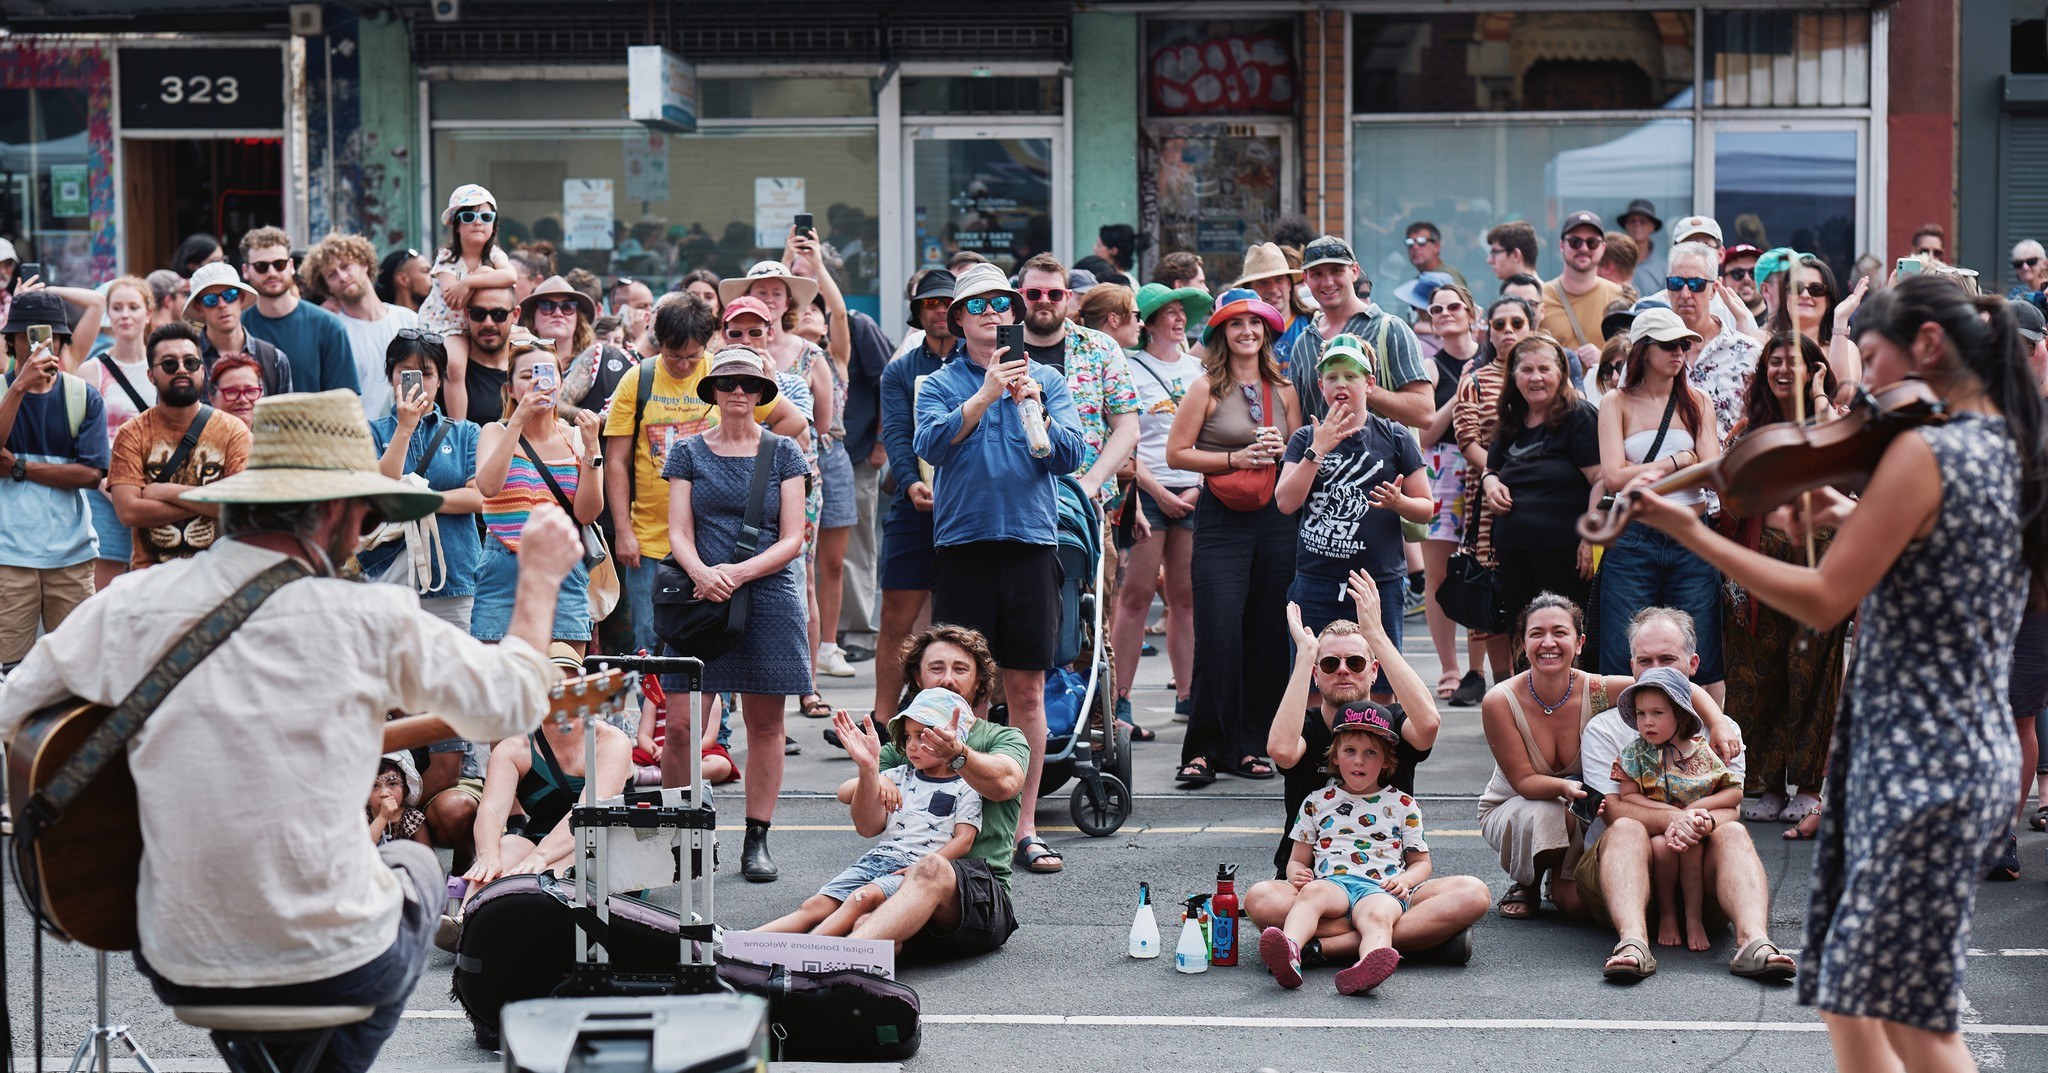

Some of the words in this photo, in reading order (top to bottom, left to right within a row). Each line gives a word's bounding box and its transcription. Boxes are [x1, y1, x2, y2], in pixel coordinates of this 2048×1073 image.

[160, 76, 240, 104] 323
[651, 394, 680, 406] umpty
[1303, 513, 1360, 541] CATS!
[1300, 529, 1328, 546] GRAND
[1330, 538, 1367, 550] FINAL
[1305, 544, 1319, 555] CATS
[1324, 550, 1351, 559] SWANS
[1345, 708, 1364, 723] Stay
[1364, 707, 1390, 729] Classy
